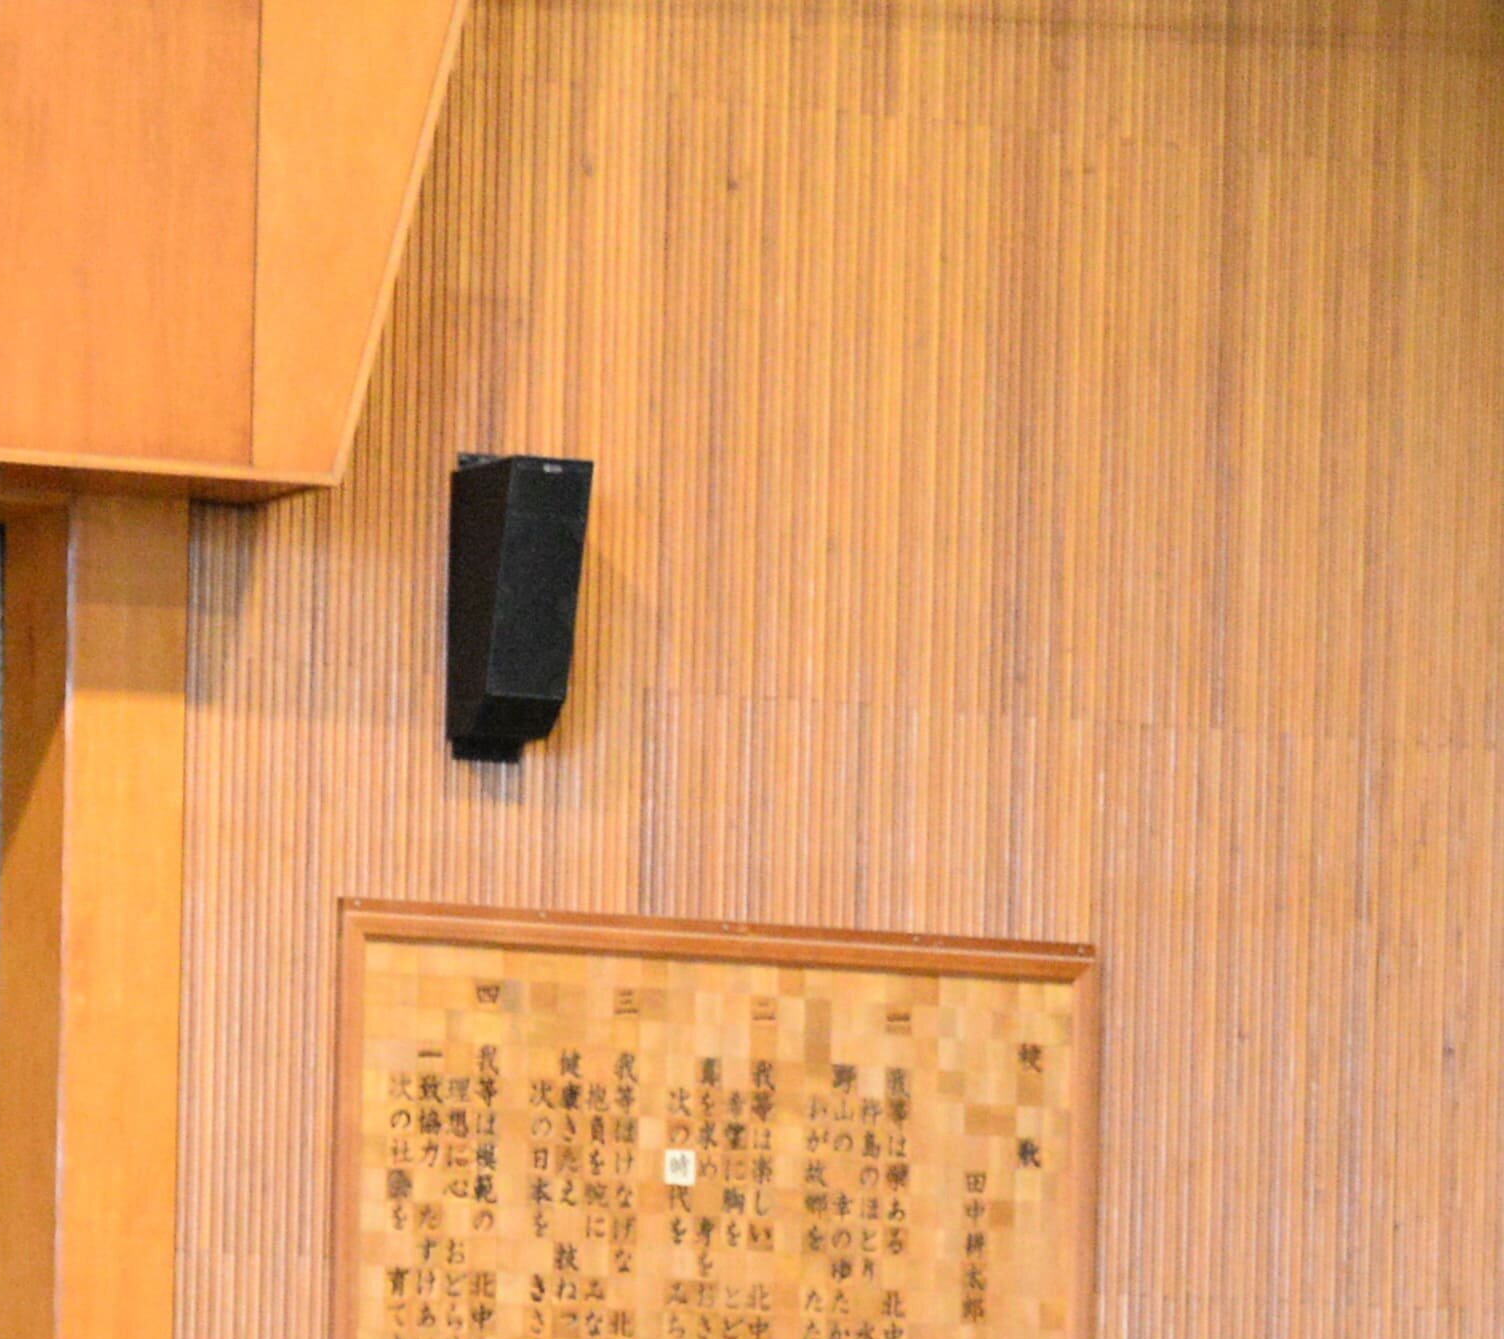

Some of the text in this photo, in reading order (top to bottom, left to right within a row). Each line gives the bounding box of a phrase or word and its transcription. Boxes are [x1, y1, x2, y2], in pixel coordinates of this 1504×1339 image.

[476, 984, 501, 1005] 四
[614, 988, 639, 1015] 三
[418, 1049, 444, 1168] 一致協力
[444, 1077, 471, 1199] 理想に心
[529, 1079, 555, 1238] 次の日本を
[832, 1063, 857, 1151] 野山の
